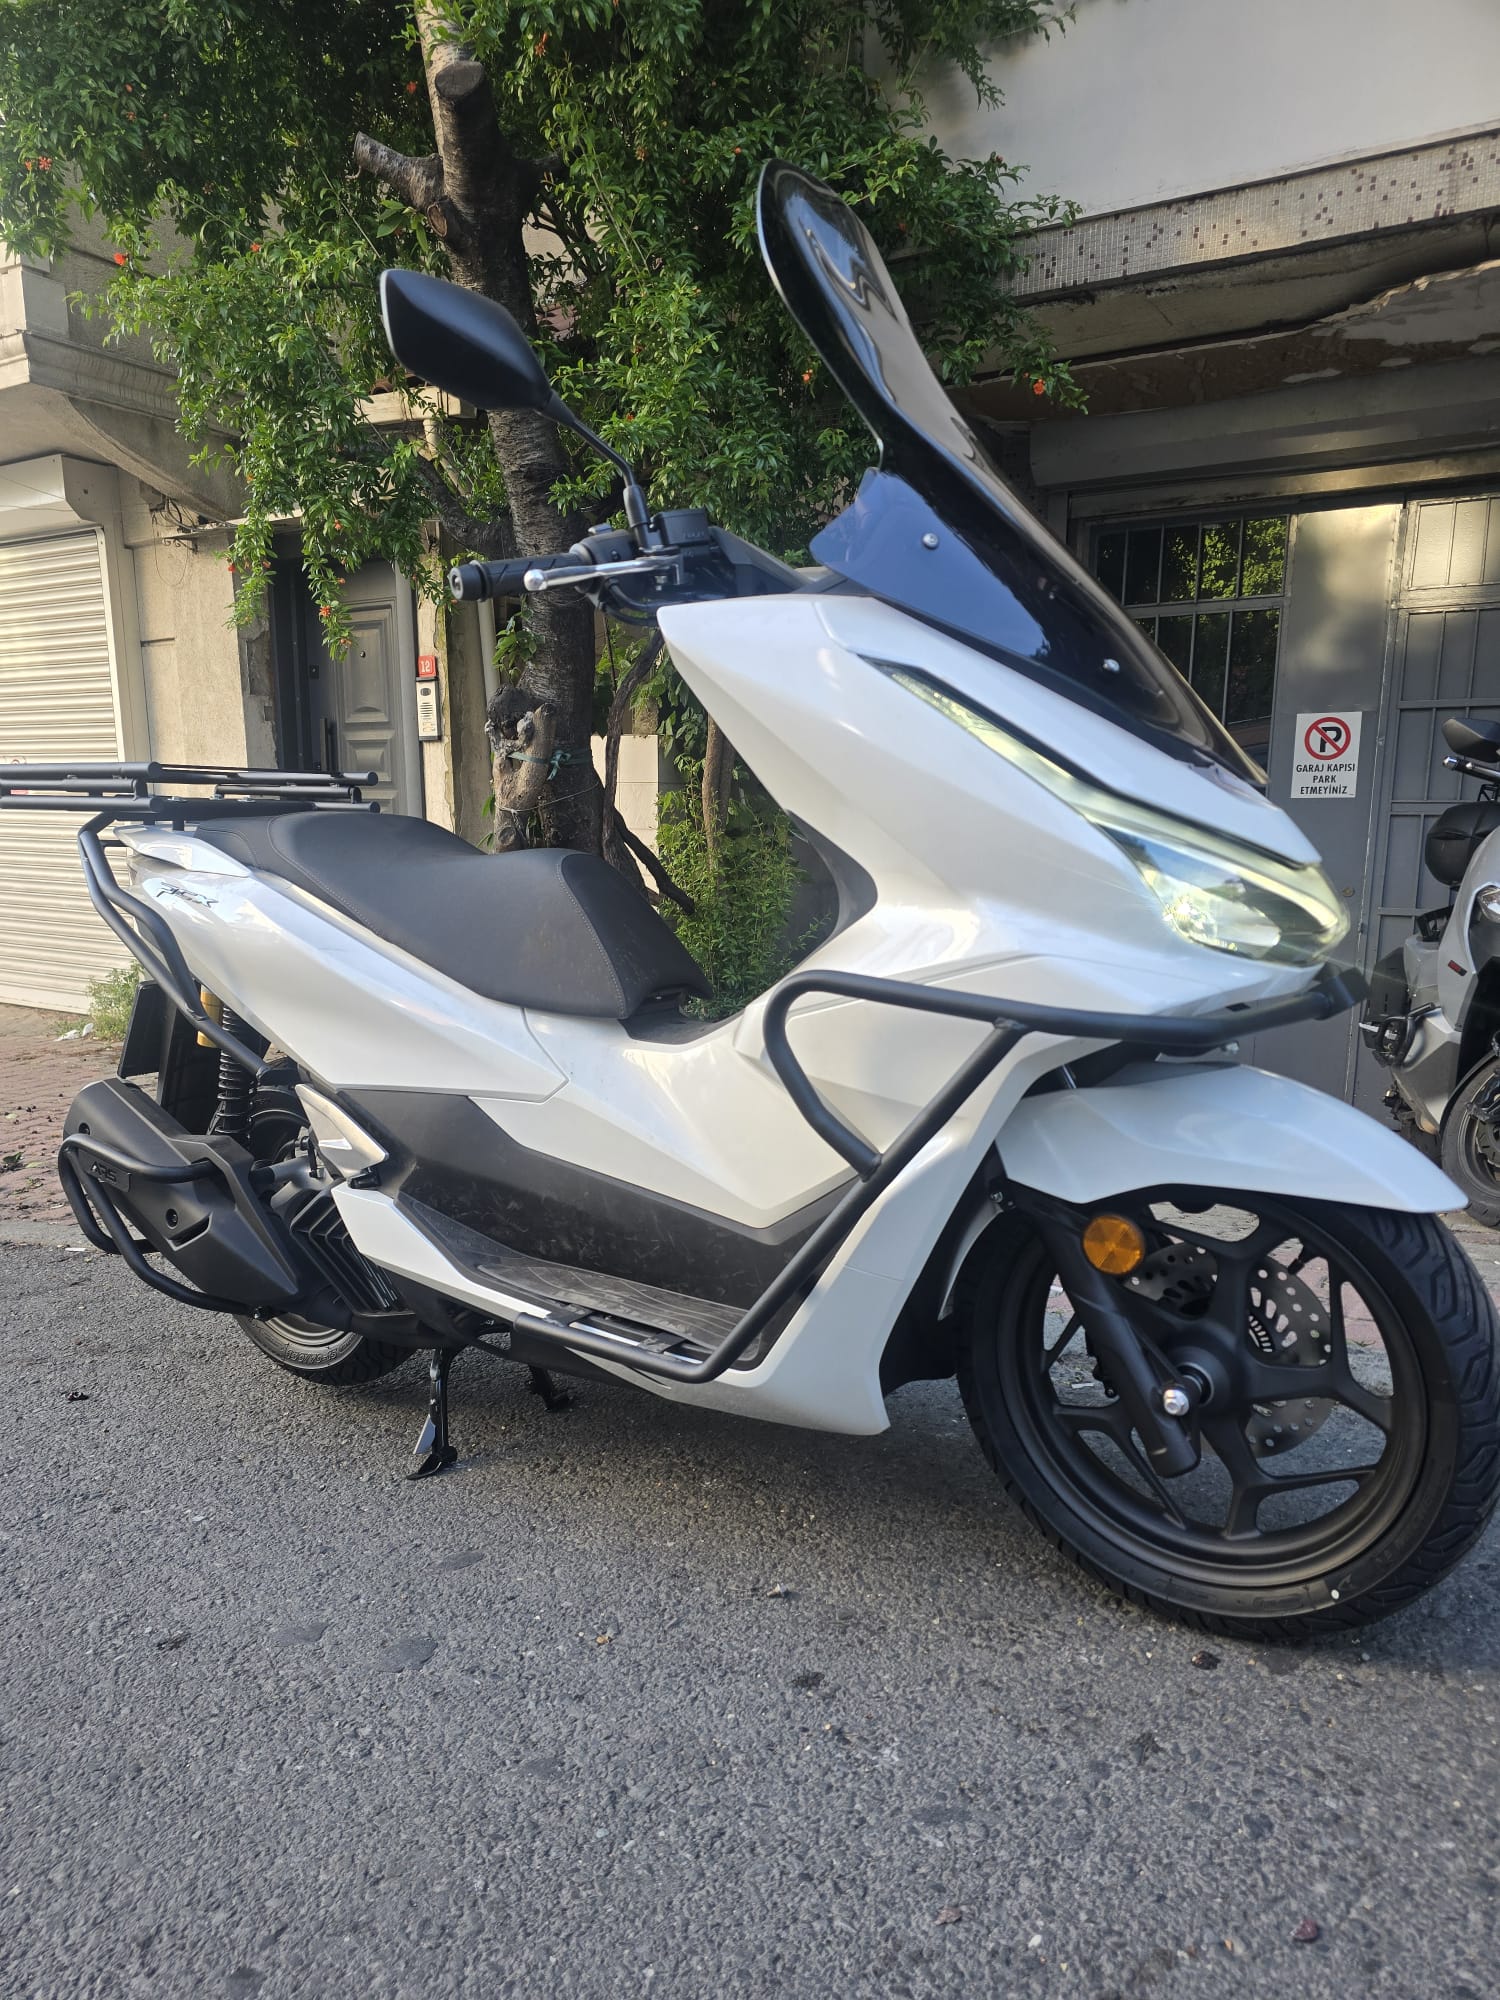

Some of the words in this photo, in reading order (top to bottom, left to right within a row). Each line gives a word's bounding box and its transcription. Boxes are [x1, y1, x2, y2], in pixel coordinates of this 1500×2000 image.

[420, 660, 431, 672] 12
[1296, 763, 1325, 773] GARAJ
[1327, 763, 1356, 772] KAPISI
[1313, 775, 1337, 784] PARK
[1300, 784, 1348, 795] ETMEYİNİZ
[156, 882, 219, 908] PCX
